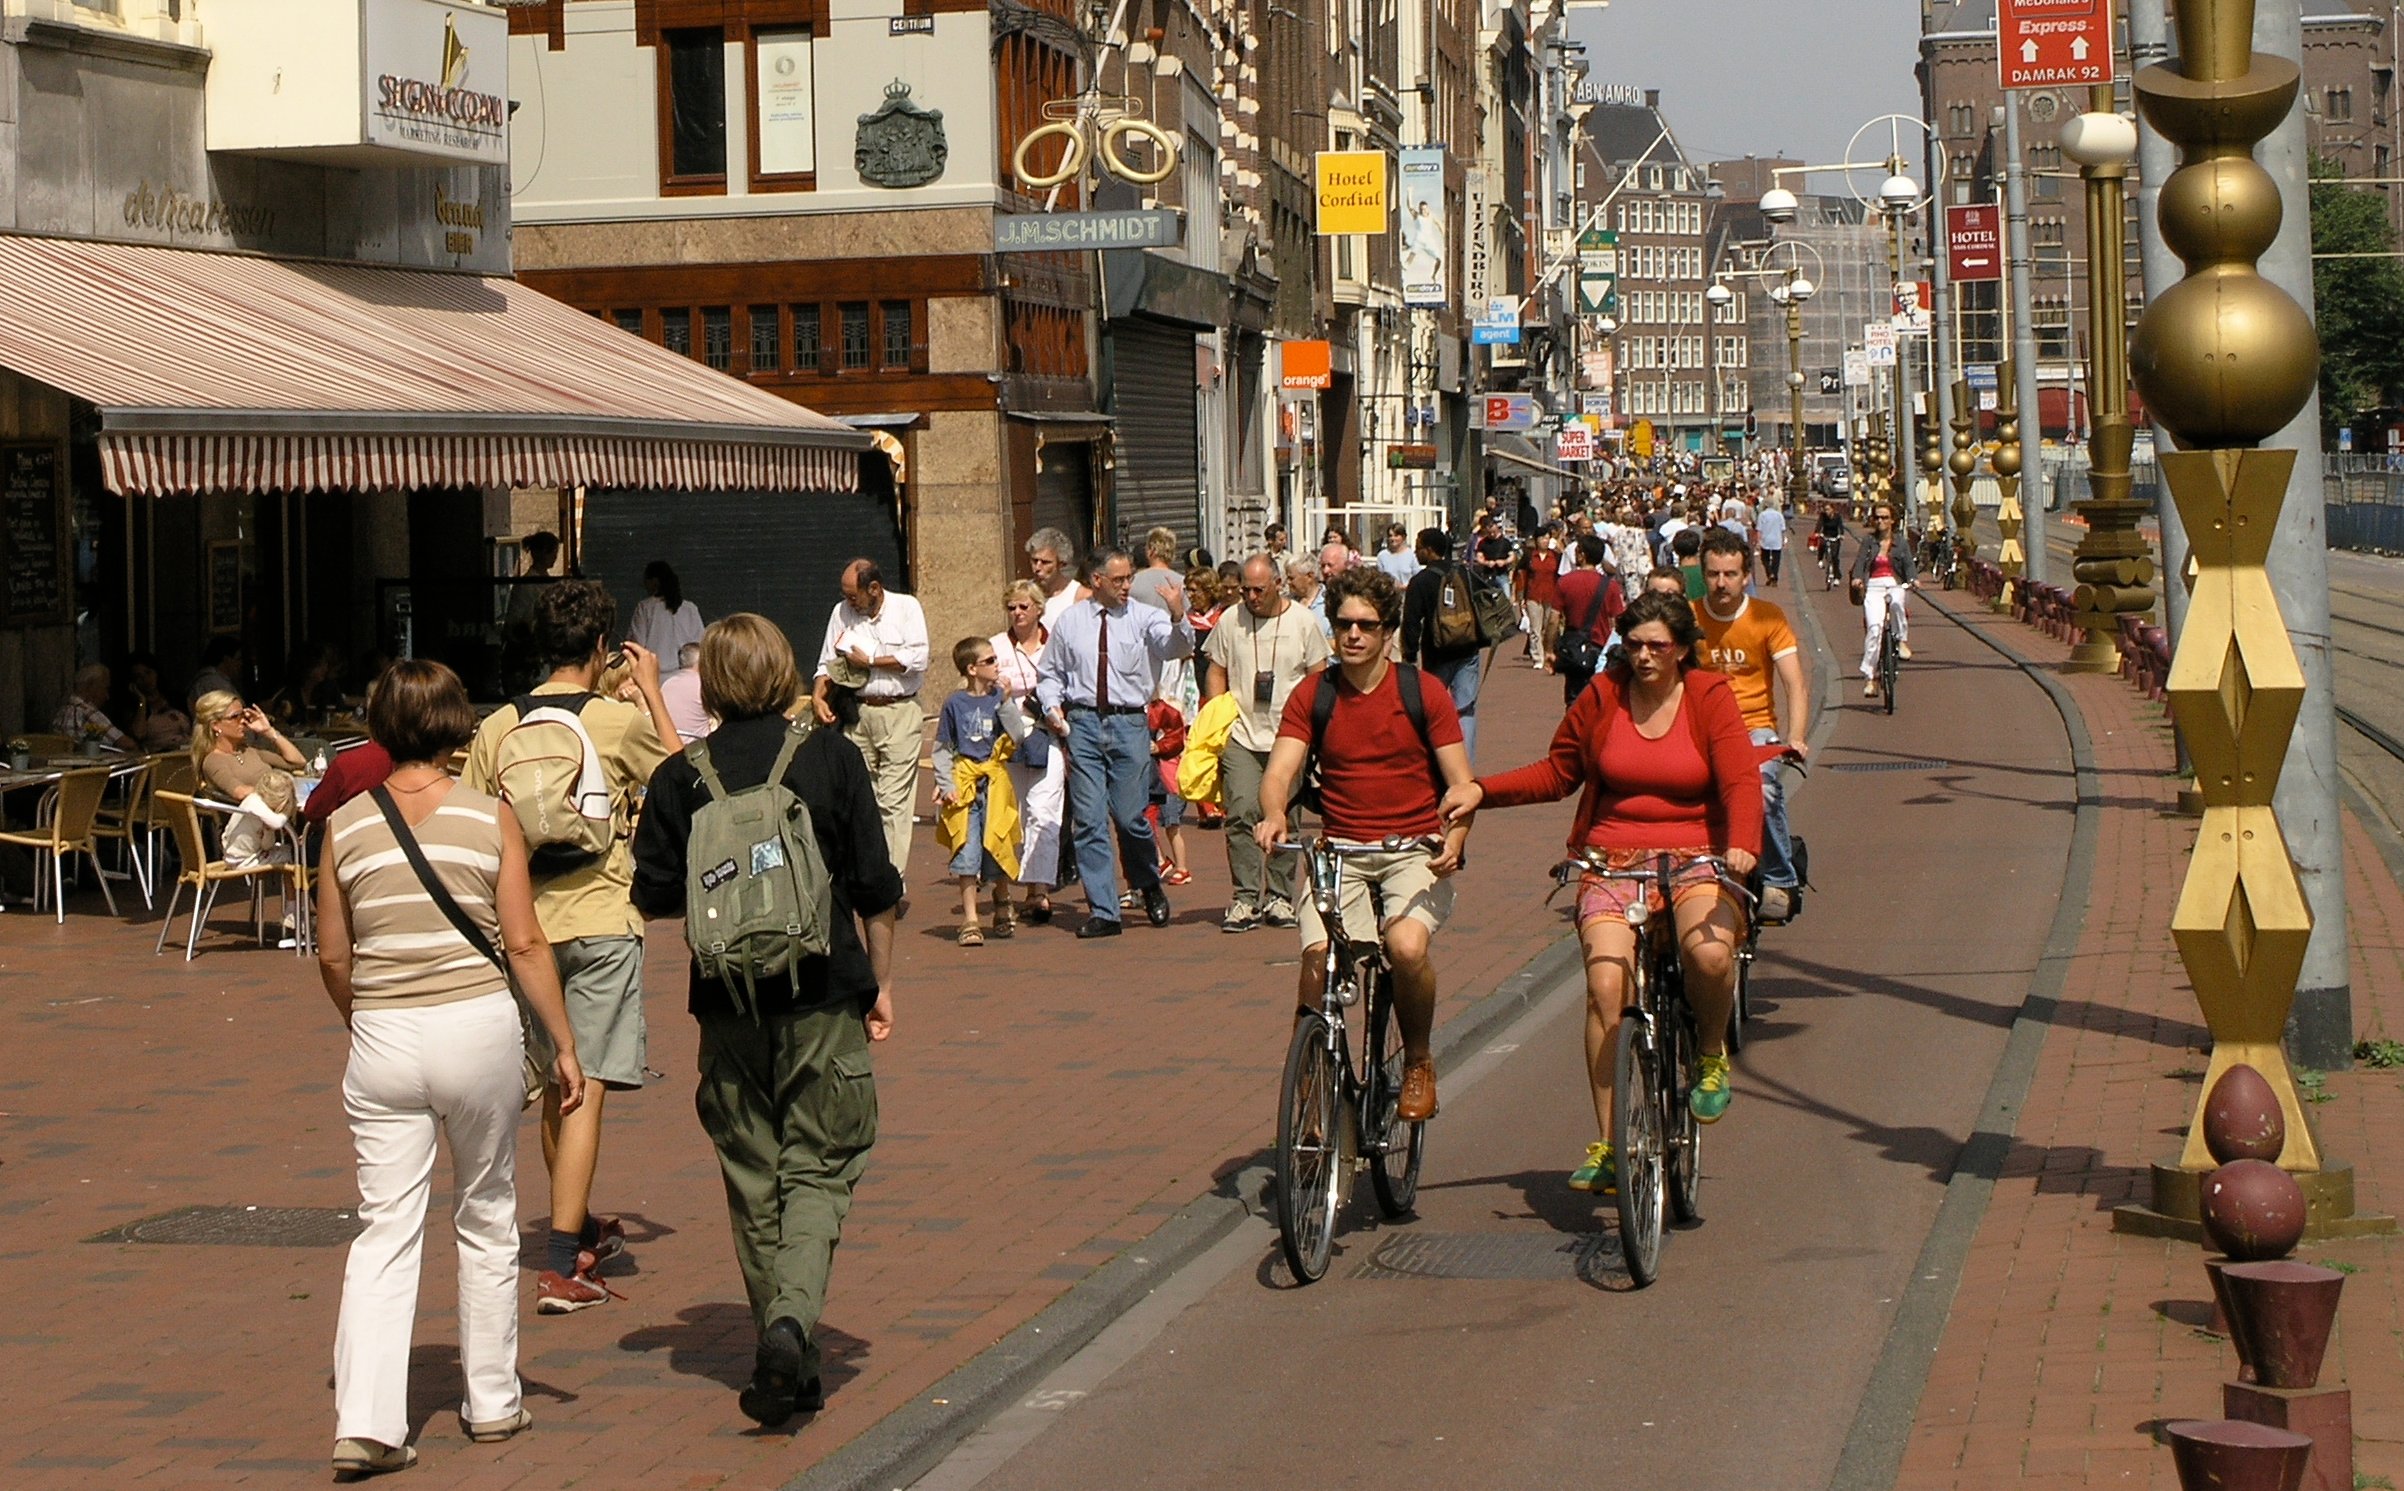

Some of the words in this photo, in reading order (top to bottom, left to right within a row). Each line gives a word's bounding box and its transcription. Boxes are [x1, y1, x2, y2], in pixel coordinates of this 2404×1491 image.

[2018, 20, 2087, 36] Express
[2012, 67, 2076, 82] DAMRAK
[2081, 66, 2099, 79] 92
[1605, 84, 1640, 104] AMRO
[1328, 169, 1373, 186] Hotel
[1319, 190, 1381, 207] Cordial
[446, 232, 474, 255] BIER
[1952, 230, 1996, 243] HOTEL
[1479, 329, 1511, 341] agent
[1562, 431, 1586, 444] SUPER
[1558, 445, 1590, 458] MARKET
[533, 769, 550, 835] Quechua
